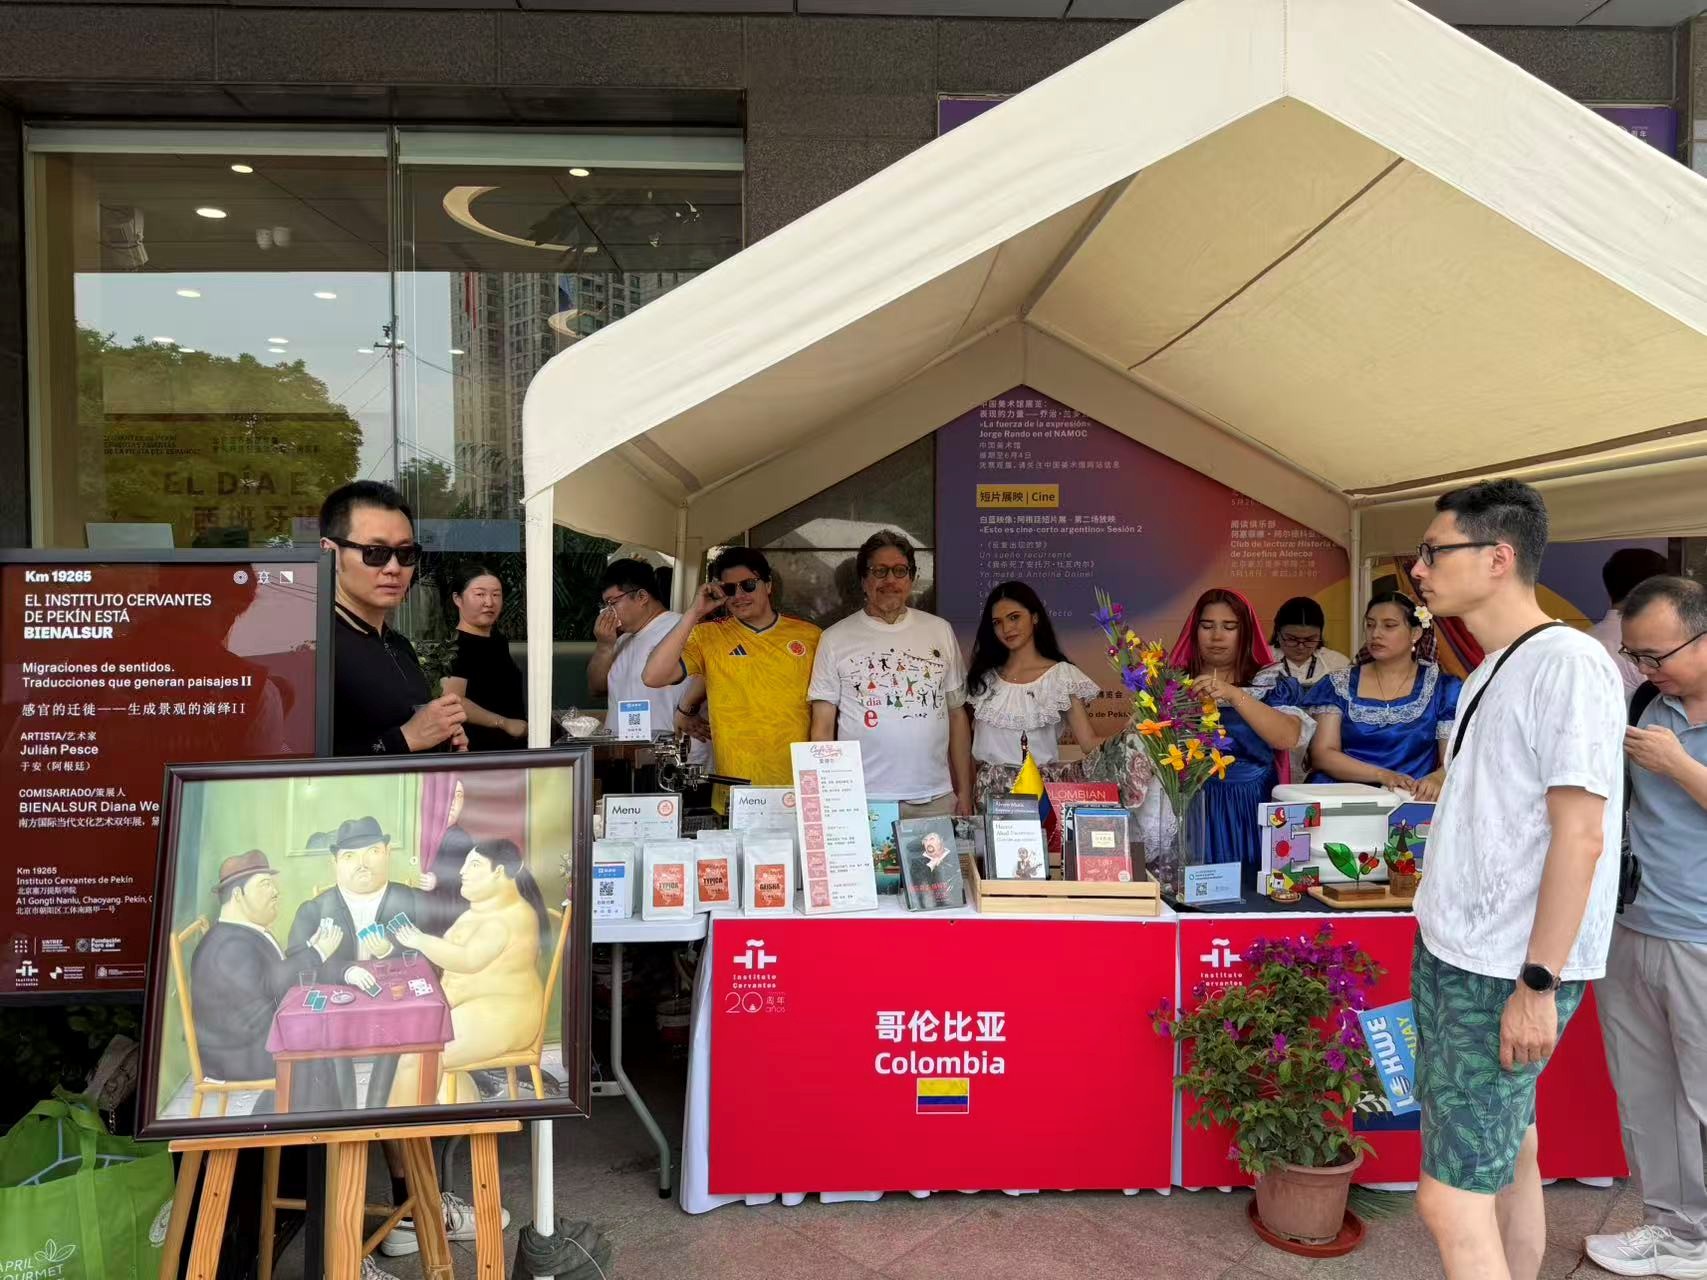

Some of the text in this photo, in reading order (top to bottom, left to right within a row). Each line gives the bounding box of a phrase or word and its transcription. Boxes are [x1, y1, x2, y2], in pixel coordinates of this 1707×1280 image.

[996, 420, 1023, 428] fuerza
[1024, 420, 1035, 428] de
[1036, 420, 1044, 428] la
[979, 430, 1003, 439] Jorge
[1004, 430, 1031, 438] Rando
[1044, 430, 1052, 438] el
[164, 472, 205, 495] EL
[290, 471, 308, 495] E
[980, 491, 1023, 502] 短片展映
[1031, 491, 1055, 501] Cine
[1107, 525, 1135, 533] Sesión
[1136, 525, 1142, 533] 2
[1231, 540, 1250, 549] Club
[1251, 541, 1262, 549] de
[979, 551, 991, 559] Un
[1231, 550, 1313, 559] de Josefina Aldecoa
[25, 570, 92, 582] Km 19265
[25, 593, 212, 607] EL INSTITUTO CERVANTES
[24, 608, 130, 623] DE PEKÍN ESTÁ
[24, 626, 113, 639] BIENALSUR
[22, 662, 175, 675] Migraciones de sentidos.
[22, 676, 252, 689] Traducciones que generan paisajes II
[864, 709, 878, 728] e
[20, 731, 97, 742] ARTISTA/艺术家
[20, 743, 99, 756] Julián Pesce
[1049, 790, 1106, 799] LOMBIAN
[19, 801, 97, 813] BIENALSUR
[100, 801, 137, 812] Diana
[738, 797, 767, 806] Menu
[612, 806, 641, 815] Menu
[32, 867, 57, 875] 19265
[17, 875, 133, 885] Instituto Cervantes de Pekín
[16, 897, 26, 905] A1
[28, 897, 55, 906] Gongti
[725, 991, 763, 1013] 20
[874, 1010, 1007, 1043] 哥伦比亚
[874, 1050, 1006, 1075] Colombia
[0, 1264, 65, 1280] OURMET
